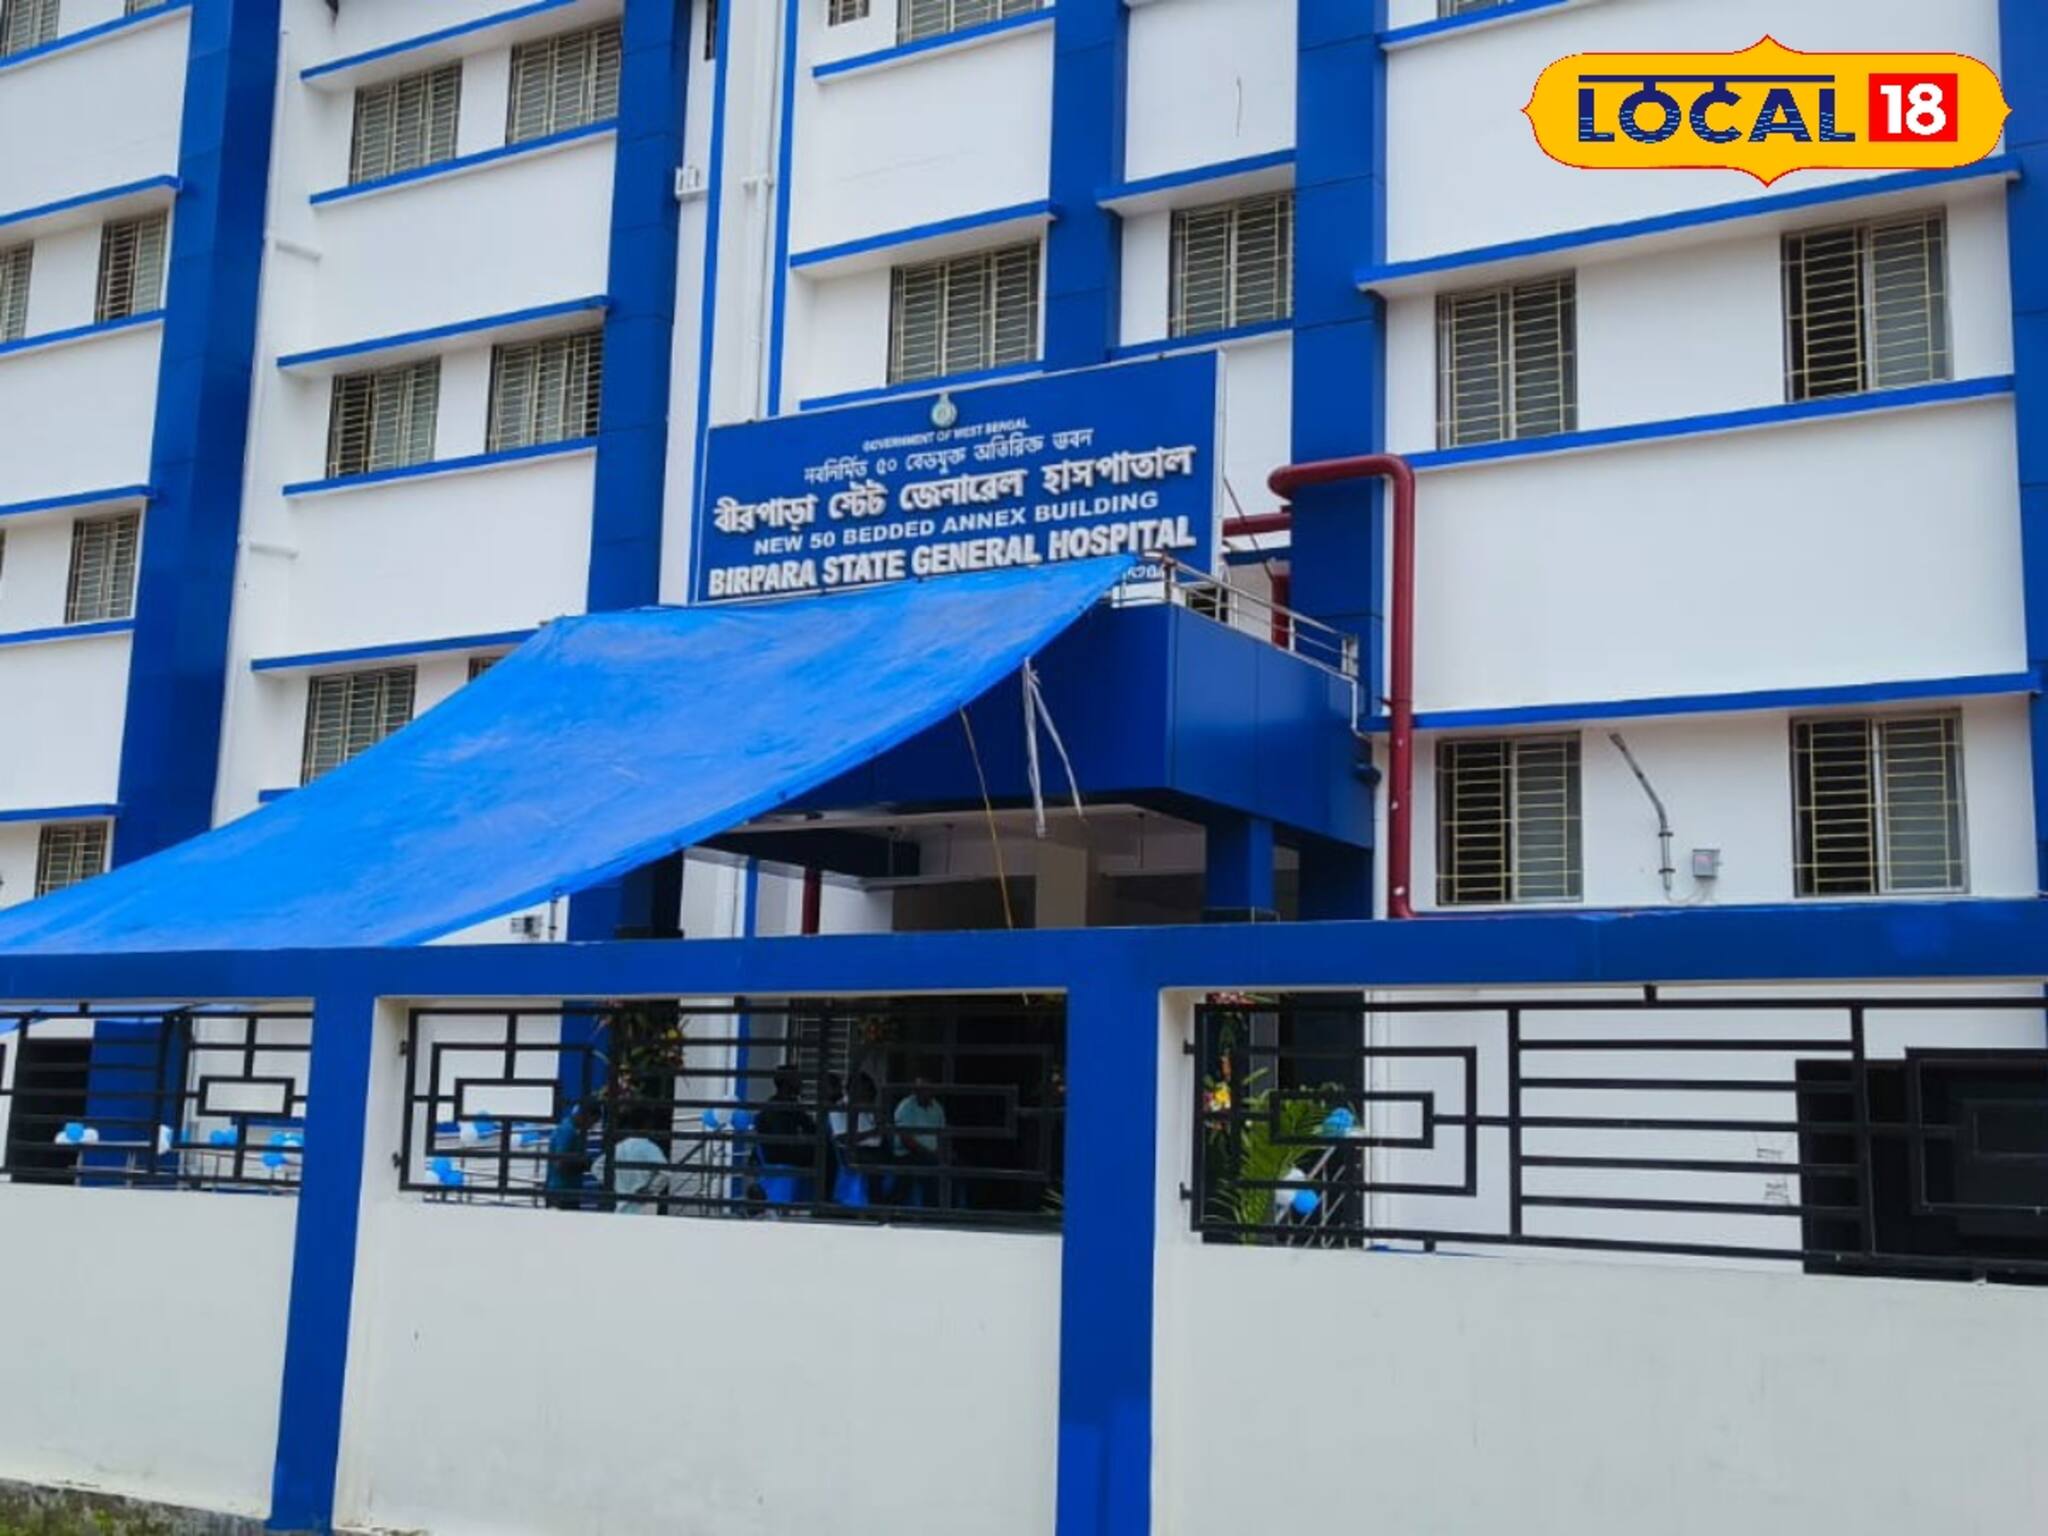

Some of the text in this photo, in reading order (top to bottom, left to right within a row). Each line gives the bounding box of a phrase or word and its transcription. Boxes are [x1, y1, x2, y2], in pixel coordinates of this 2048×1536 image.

[864, 418, 1029, 451] GOVERNMENT OF WEST BENGAL
[876, 458, 898, 475] ৫০
[974, 432, 1044, 460] অতিরিক্ত
[1053, 429, 1093, 449] ভবন
[714, 445, 1197, 533] বীরপাড়া স্টেট জেনারেল হাসপাতাল
[754, 490, 1159, 555] NEW 50 BEDDED ANNEX BUILDING
[708, 514, 1197, 597] BIRPARA STATE GENERAL HOSPITAL
